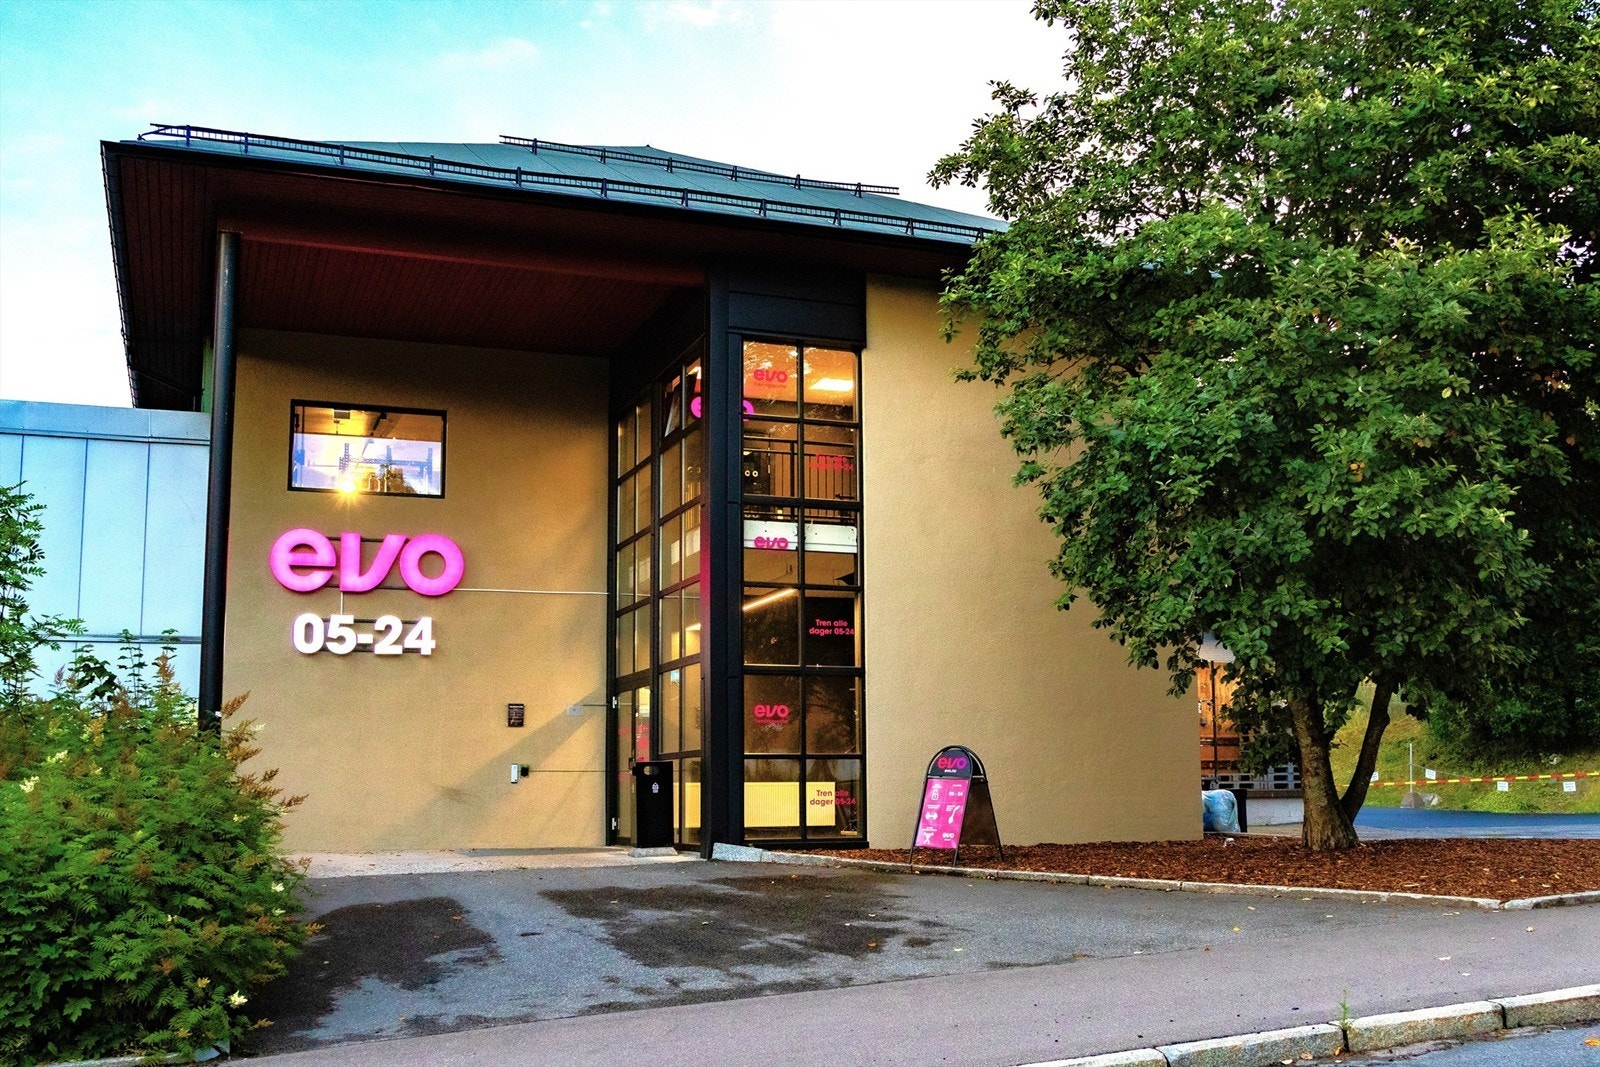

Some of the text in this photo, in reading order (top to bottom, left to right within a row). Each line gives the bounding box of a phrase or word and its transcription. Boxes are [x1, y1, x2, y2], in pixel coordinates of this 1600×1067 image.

[754, 369, 788, 383] evo
[754, 536, 789, 550] evo
[270, 528, 465, 596] evo
[815, 619, 832, 627] Tren
[293, 613, 436, 656] 05-24
[809, 628, 832, 637] dager
[754, 704, 789, 718] evo
[937, 756, 968, 770] evo
[816, 789, 833, 797] Tren
[809, 797, 856, 807] dager 05-24
